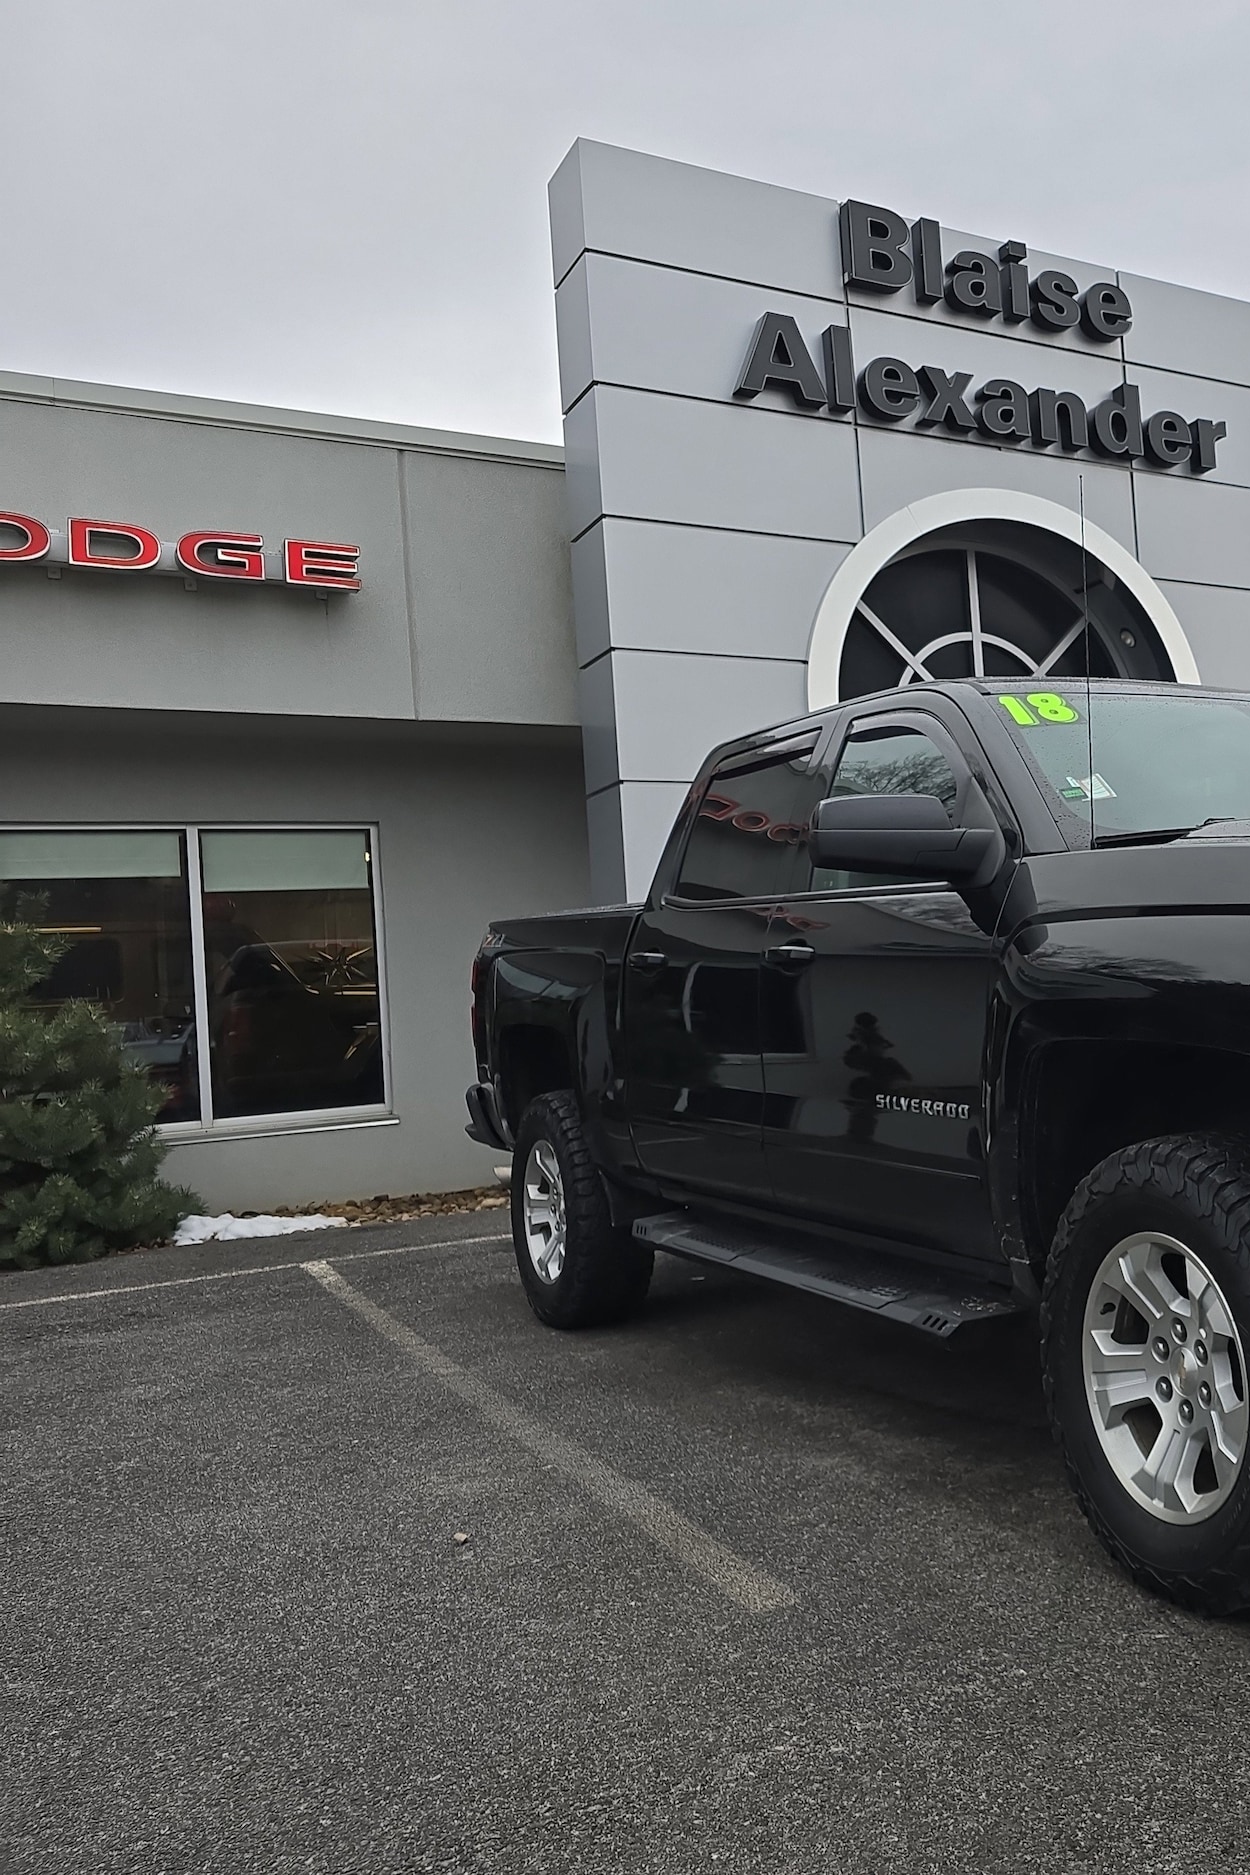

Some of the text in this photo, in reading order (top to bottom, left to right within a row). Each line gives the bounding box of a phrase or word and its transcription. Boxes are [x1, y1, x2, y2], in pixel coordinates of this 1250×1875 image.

[839, 199, 1133, 343] Blaise
[733, 312, 1227, 473] Alexander
[998, 693, 1079, 726] 18
[875, 1094, 970, 1119] SILVERADO
